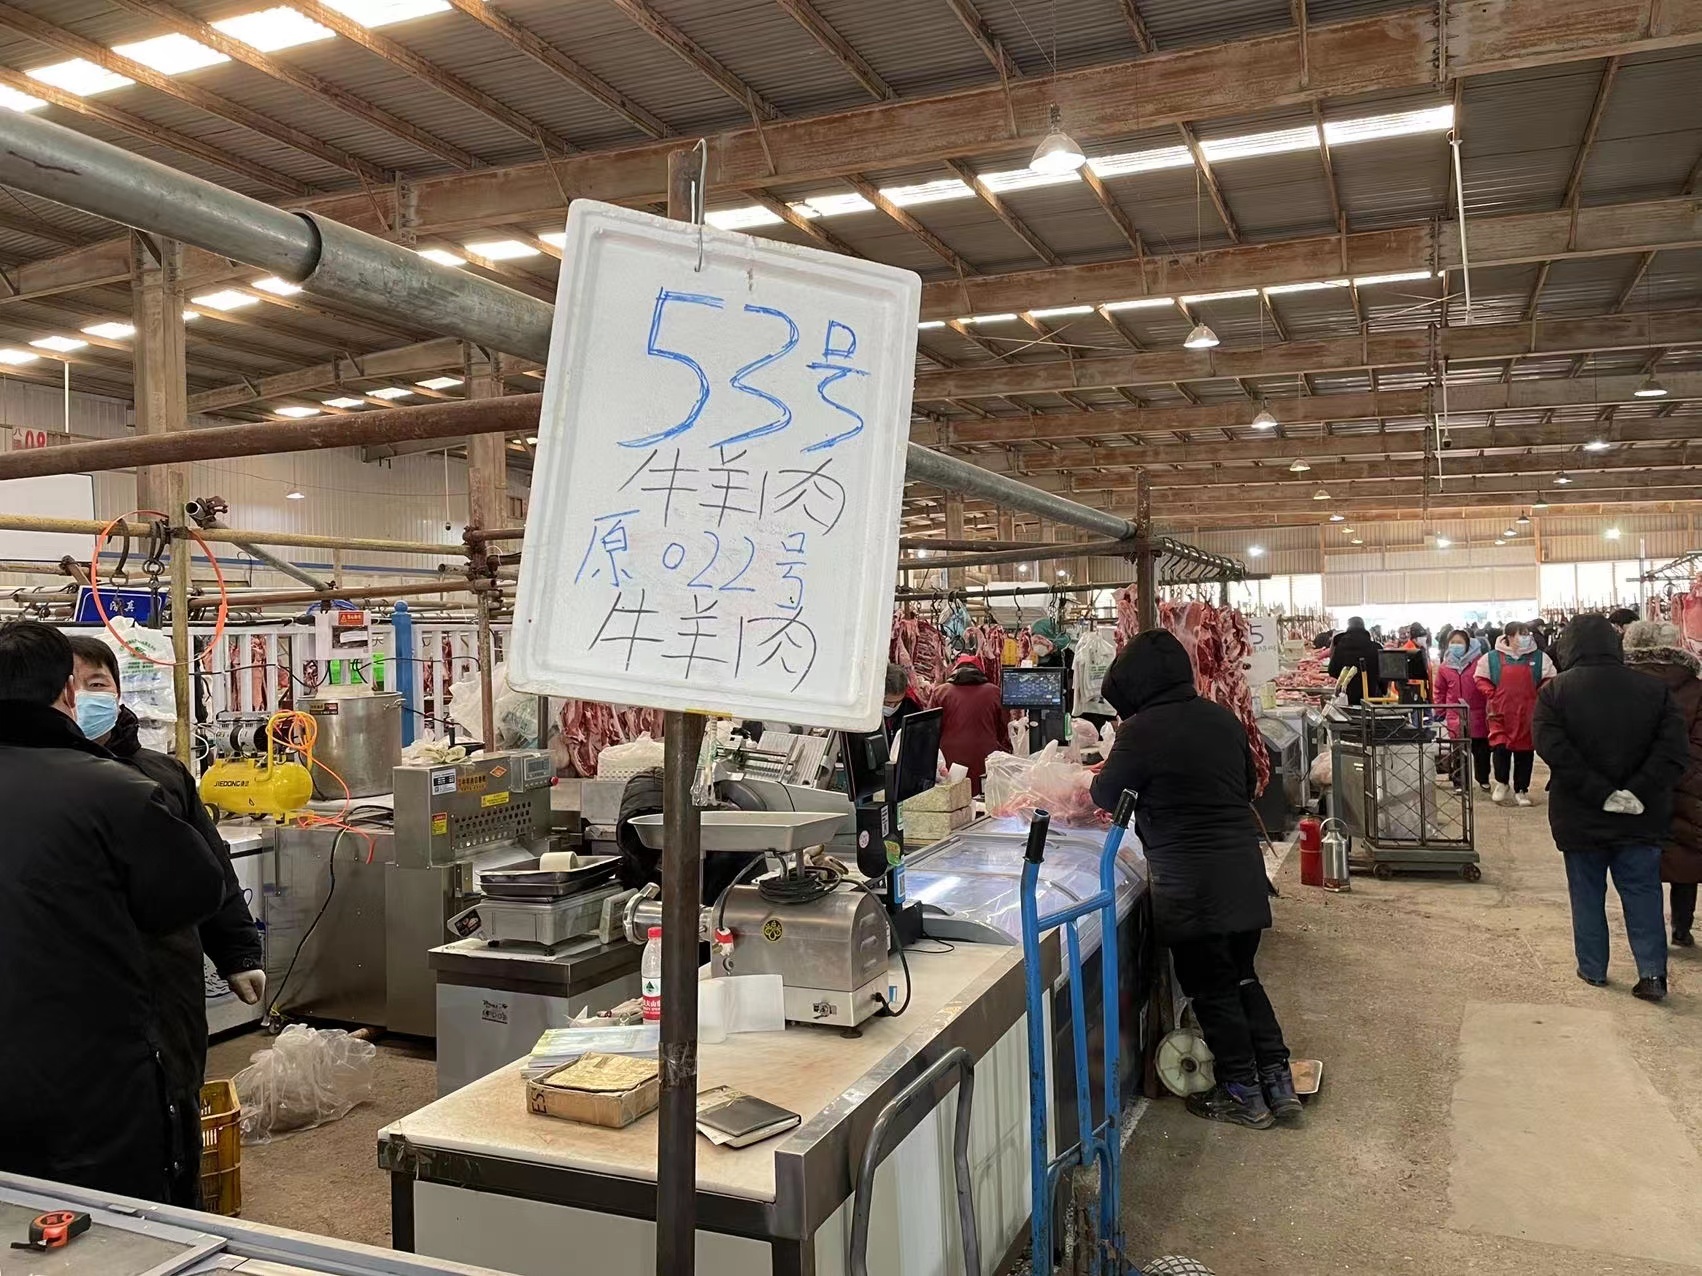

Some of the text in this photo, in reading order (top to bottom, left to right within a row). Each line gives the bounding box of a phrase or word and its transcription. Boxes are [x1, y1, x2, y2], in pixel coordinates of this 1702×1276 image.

[617, 286, 872, 453] 53号
[617, 445, 847, 535] 牛羊肉
[588, 588, 817, 693] 牛羊肉
